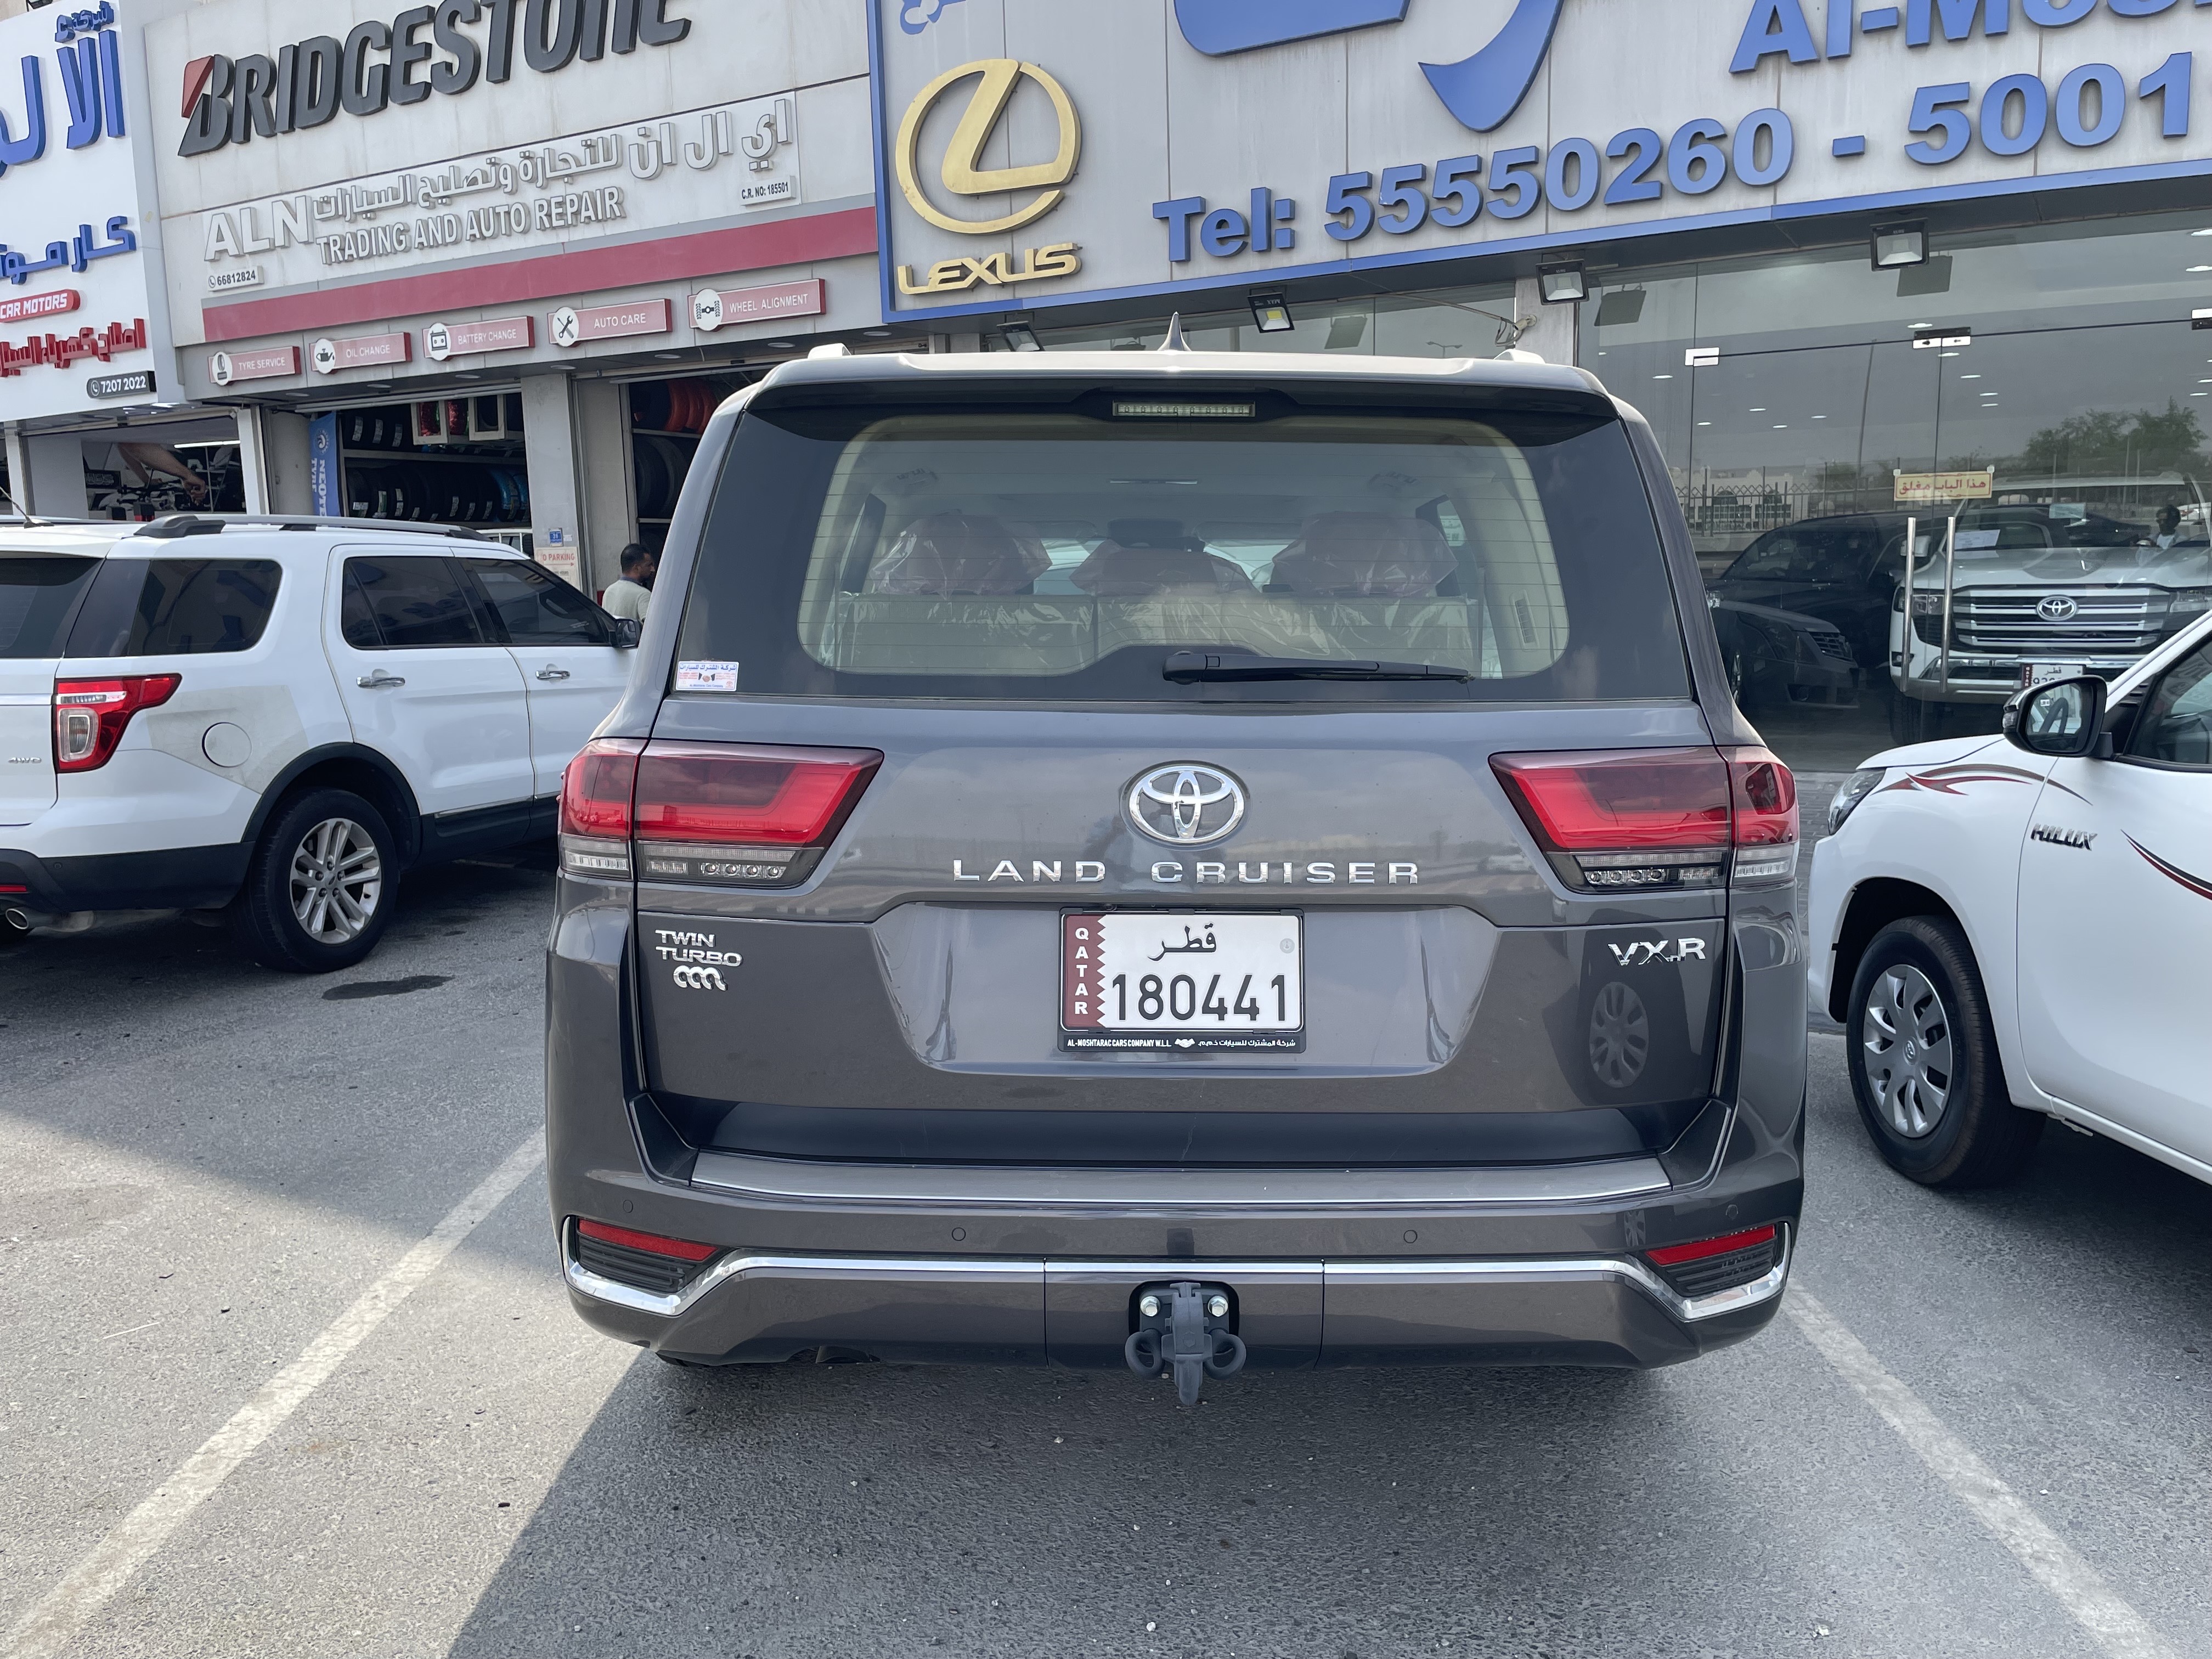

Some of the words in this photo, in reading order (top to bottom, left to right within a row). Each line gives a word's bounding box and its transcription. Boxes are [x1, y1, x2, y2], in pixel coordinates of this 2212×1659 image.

[684, 110, 733, 170] ال
[741, 98, 792, 172] اي
[518, 134, 623, 189] للتجارة
[629, 122, 678, 180] ان
[1153, 187, 1295, 262] Tel:
[1324, 108, 1793, 241] 55550260
[1904, 52, 2192, 165] 5001
[417, 157, 517, 209] وتصليح
[742, 188, 754, 199] C.R.
[755, 186, 766, 197] NO:
[768, 182, 788, 194] 185501
[313, 174, 415, 223] السيارات
[204, 195, 314, 262] ALN
[315, 222, 410, 265] TRADING
[414, 213, 462, 249] AND
[465, 202, 531, 241] AUTO
[534, 187, 626, 231] REPAIR
[72, 216, 137, 272] كار
[217, 269, 256, 286] 66812824
[897, 242, 1082, 295] LEXUS
[0, 302, 21, 319] CAR
[23, 292, 68, 315] MOTORS
[730, 301, 757, 313] WHEEL
[761, 294, 808, 310] ALIGNMENT
[594, 316, 618, 329] AUTO
[620, 313, 646, 325] CARE
[458, 332, 487, 345] BATTERY
[489, 329, 517, 342] CHANGE
[346, 347, 358, 358] OIL
[360, 344, 390, 356] CHANGE
[238, 359, 256, 371] TYRE
[256, 357, 285, 369] SERVICE
[100, 379, 122, 393] 7207
[123, 375, 146, 391] 2022
[1899, 481, 1931, 495] مغلق
[1934, 479, 1962, 492] الباب
[1967, 478, 1986, 489] هذا
[2030, 823, 2098, 851] HILUX
[953, 859, 1106, 883] LAND
[1151, 861, 1418, 884] CRUISER
[655, 929, 715, 947] TWIN
[1148, 922, 1217, 961] قطر
[656, 946, 743, 967] TURBO
[1074, 927, 1090, 1015] QATAR
[1111, 974, 1285, 1022] 180441
[1067, 1039, 1111, 1047] AL-MOSHTARAC
[1111, 1039, 1127, 1047] CARS
[1127, 1039, 1155, 1047] COMPANY
[1248, 1039, 1276, 1047] المشترك
[1276, 1039, 1296, 1047] شركة
